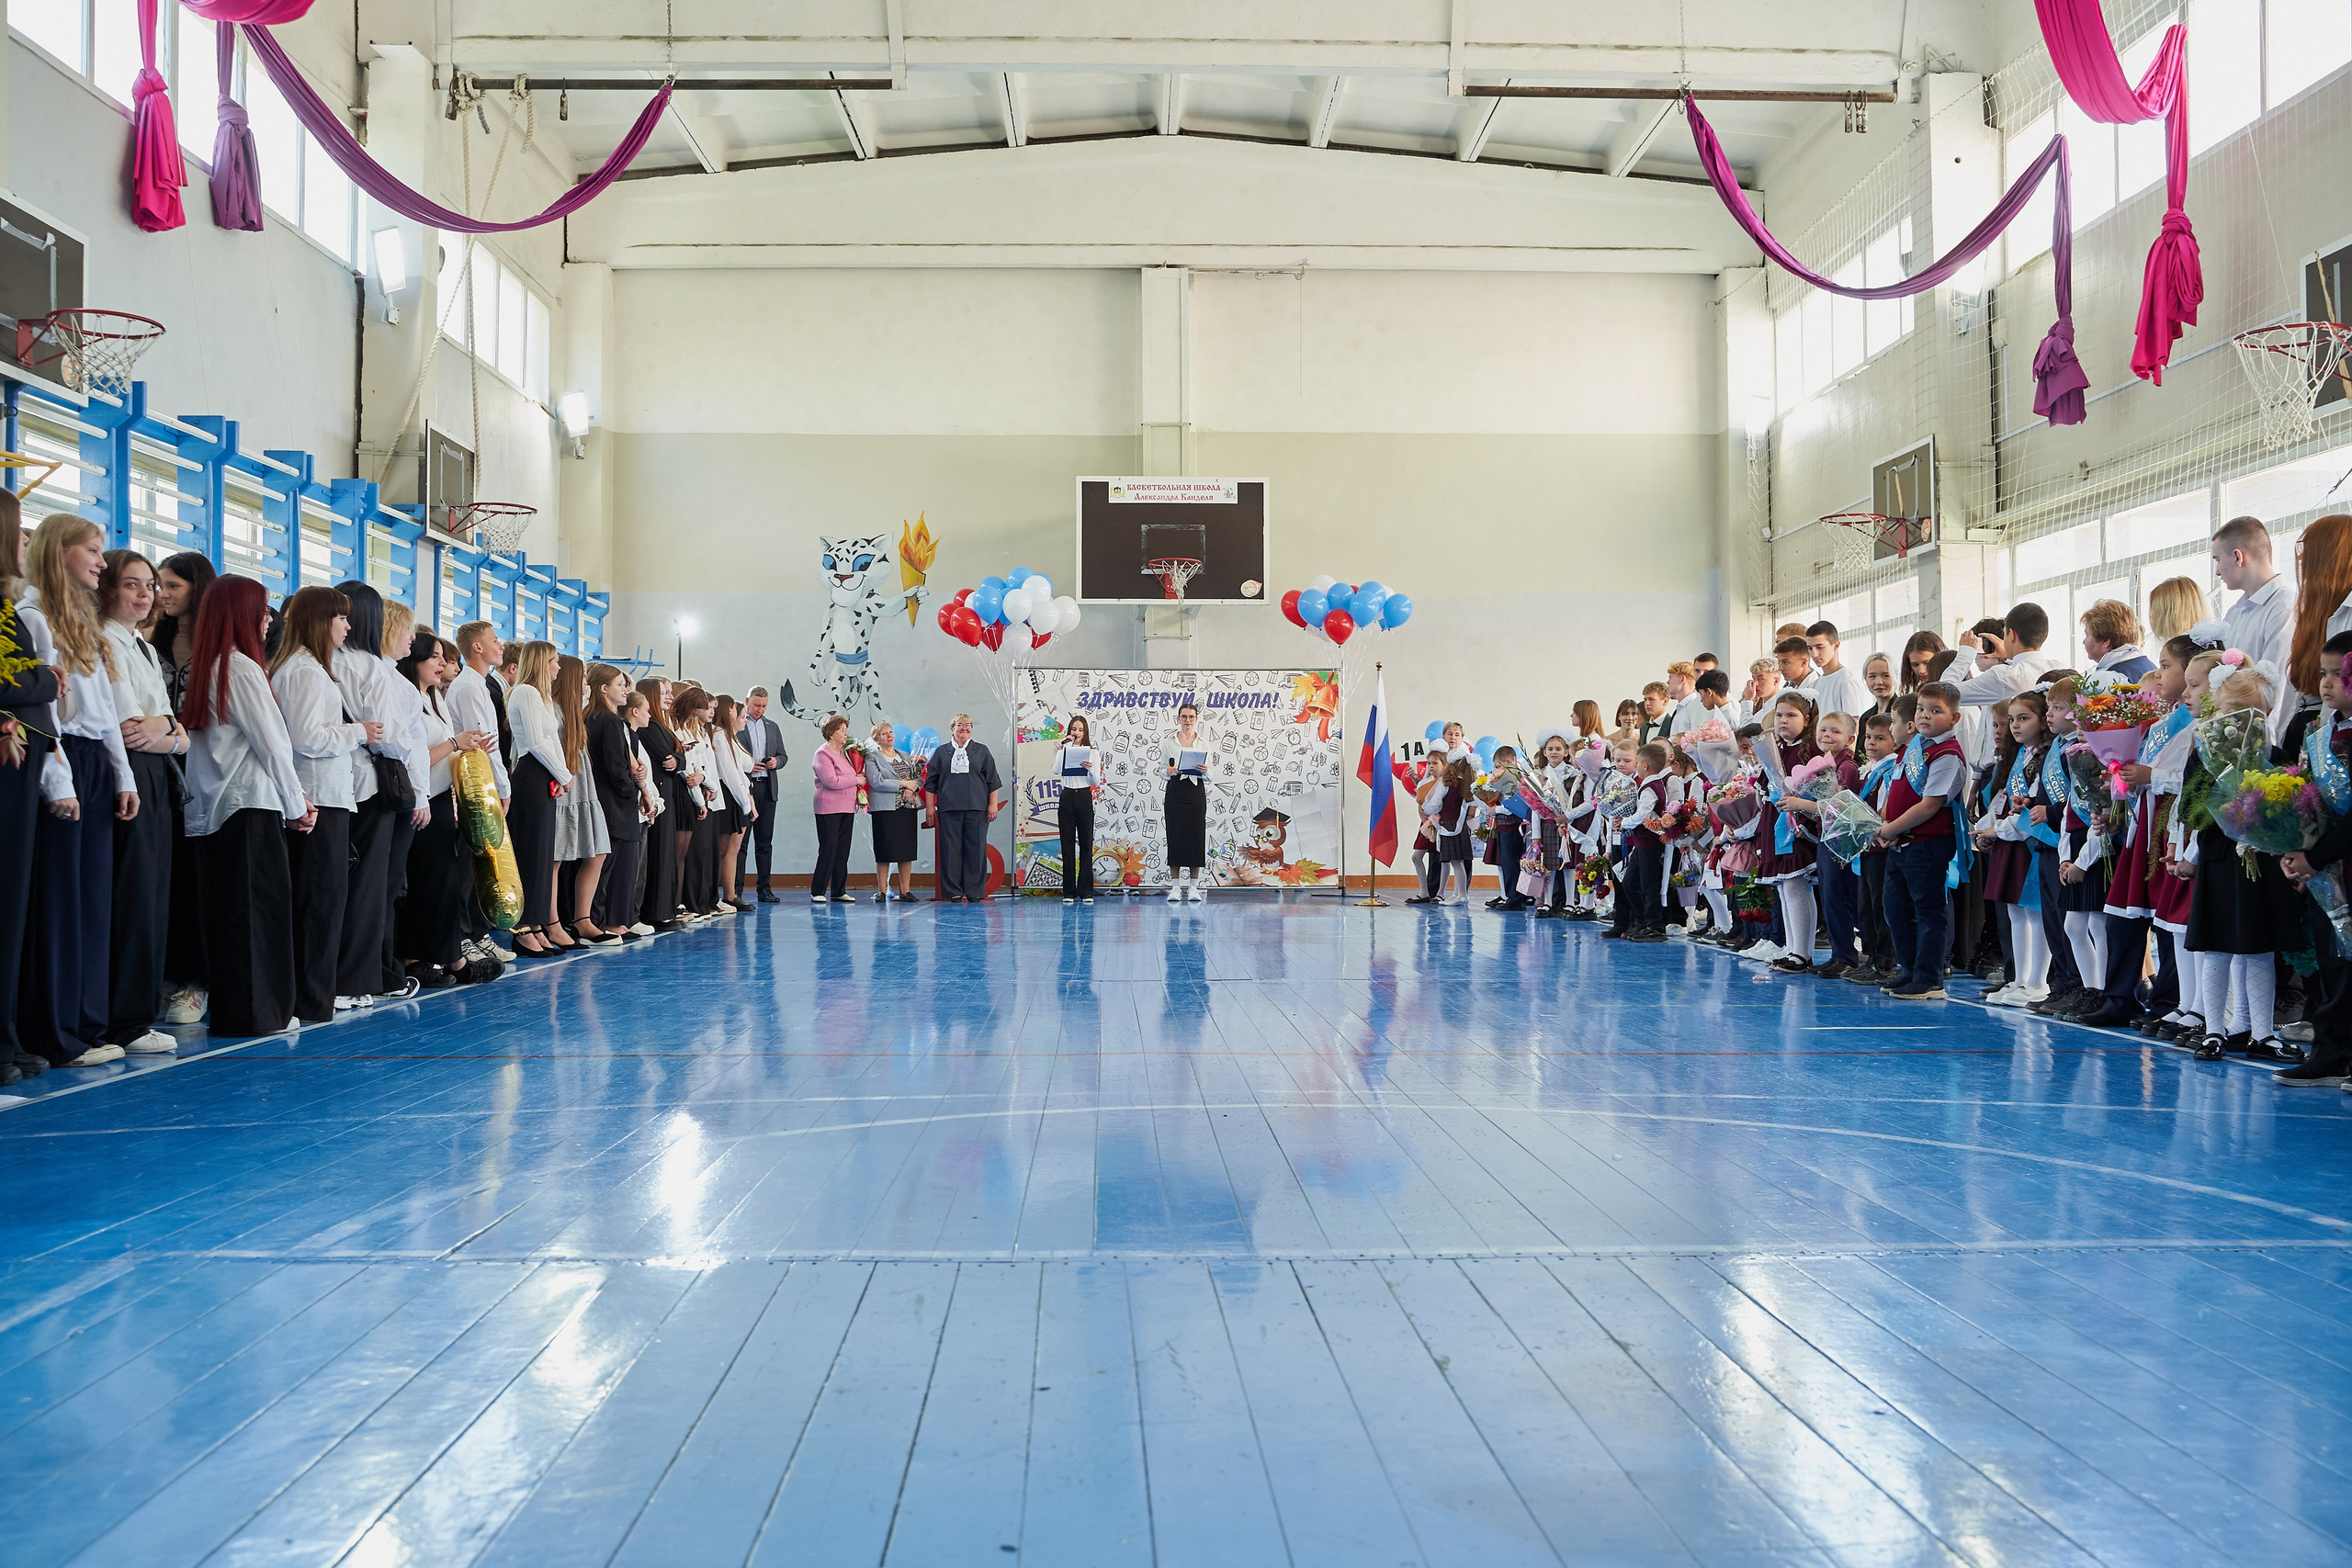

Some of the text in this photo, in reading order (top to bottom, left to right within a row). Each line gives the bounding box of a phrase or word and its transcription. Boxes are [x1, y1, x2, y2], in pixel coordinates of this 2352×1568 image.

[1134, 492, 1214, 502] Александра Канделя
[1206, 692, 1280, 709] ШКОЛА!
[1400, 742, 1410, 761] 1
[1035, 779, 1063, 799] 115
